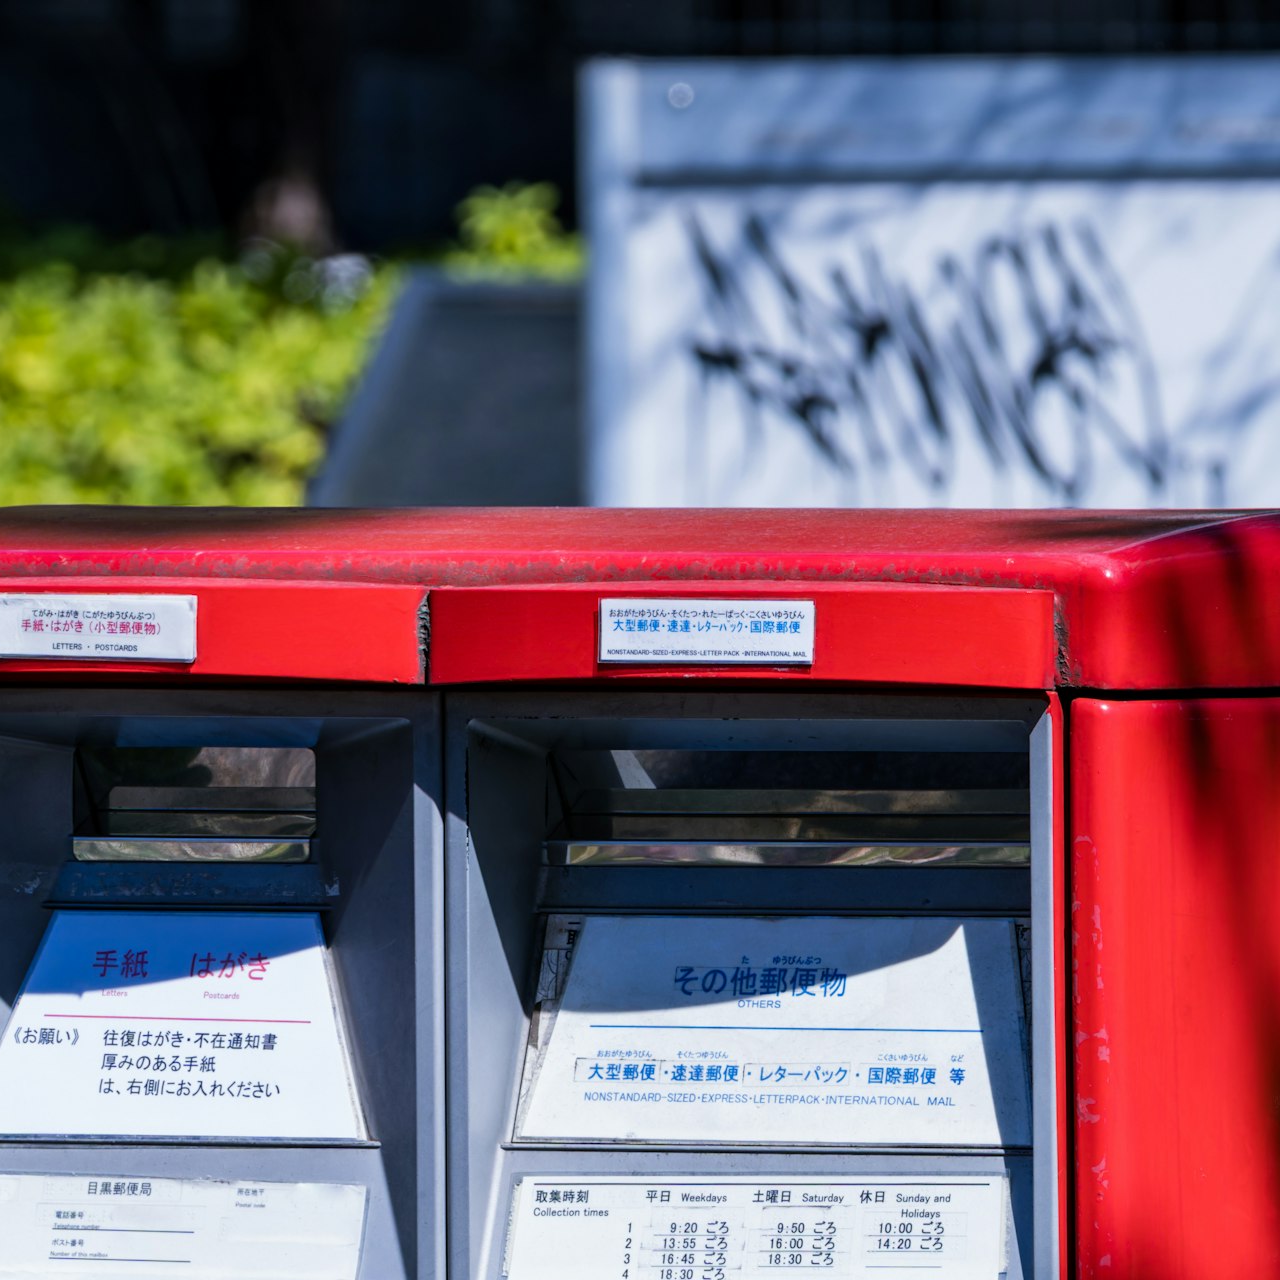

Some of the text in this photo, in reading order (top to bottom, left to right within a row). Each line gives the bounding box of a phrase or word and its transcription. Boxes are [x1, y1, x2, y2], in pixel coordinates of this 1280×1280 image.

[95, 644, 138, 652] POSTCARDS
[93, 949, 271, 981] 手紙 はがき
[675, 967, 847, 997] その他郵便物
[101, 989, 240, 999] Letters Postcards
[738, 1000, 781, 1008] OTHERS
[103, 1029, 278, 1050] 往復はがき・不在通知書
[101, 1053, 216, 1073] 厚みのある手紙
[949, 1067, 966, 1085] 等
[99, 1078, 280, 1098] は、右側にお入れください
[927, 1096, 955, 1106] MAIL
[87, 1181, 152, 1196] 目黒郵便局
[535, 1190, 589, 1203] 取集時刻
[646, 1190, 727, 1204] 平日 Weekdays
[752, 1190, 844, 1204] 土曜日 Saturday
[860, 1190, 951, 1204] 休日 Sunday and
[55, 1211, 84, 1219] 電話番号
[533, 1207, 609, 1217] Collection times
[901, 1209, 940, 1219] Holidays
[670, 1222, 698, 1234] 9:20
[706, 1220, 729, 1234] ごろ
[777, 1220, 837, 1234] 9:50 ごろ
[878, 1220, 945, 1234] 10:00 ごろ
[52, 1238, 84, 1247] ポスト番号
[625, 1236, 728, 1250] 2 13:55 ごろ
[770, 1236, 835, 1250] 16:00 ごろ
[877, 1236, 943, 1250] 14:20 ごろ
[624, 1251, 726, 1265] 3 16:45 ごろ
[768, 1252, 834, 1266] 18:30 ごろ
[622, 1267, 725, 1280] 4 18:30 ごろ
